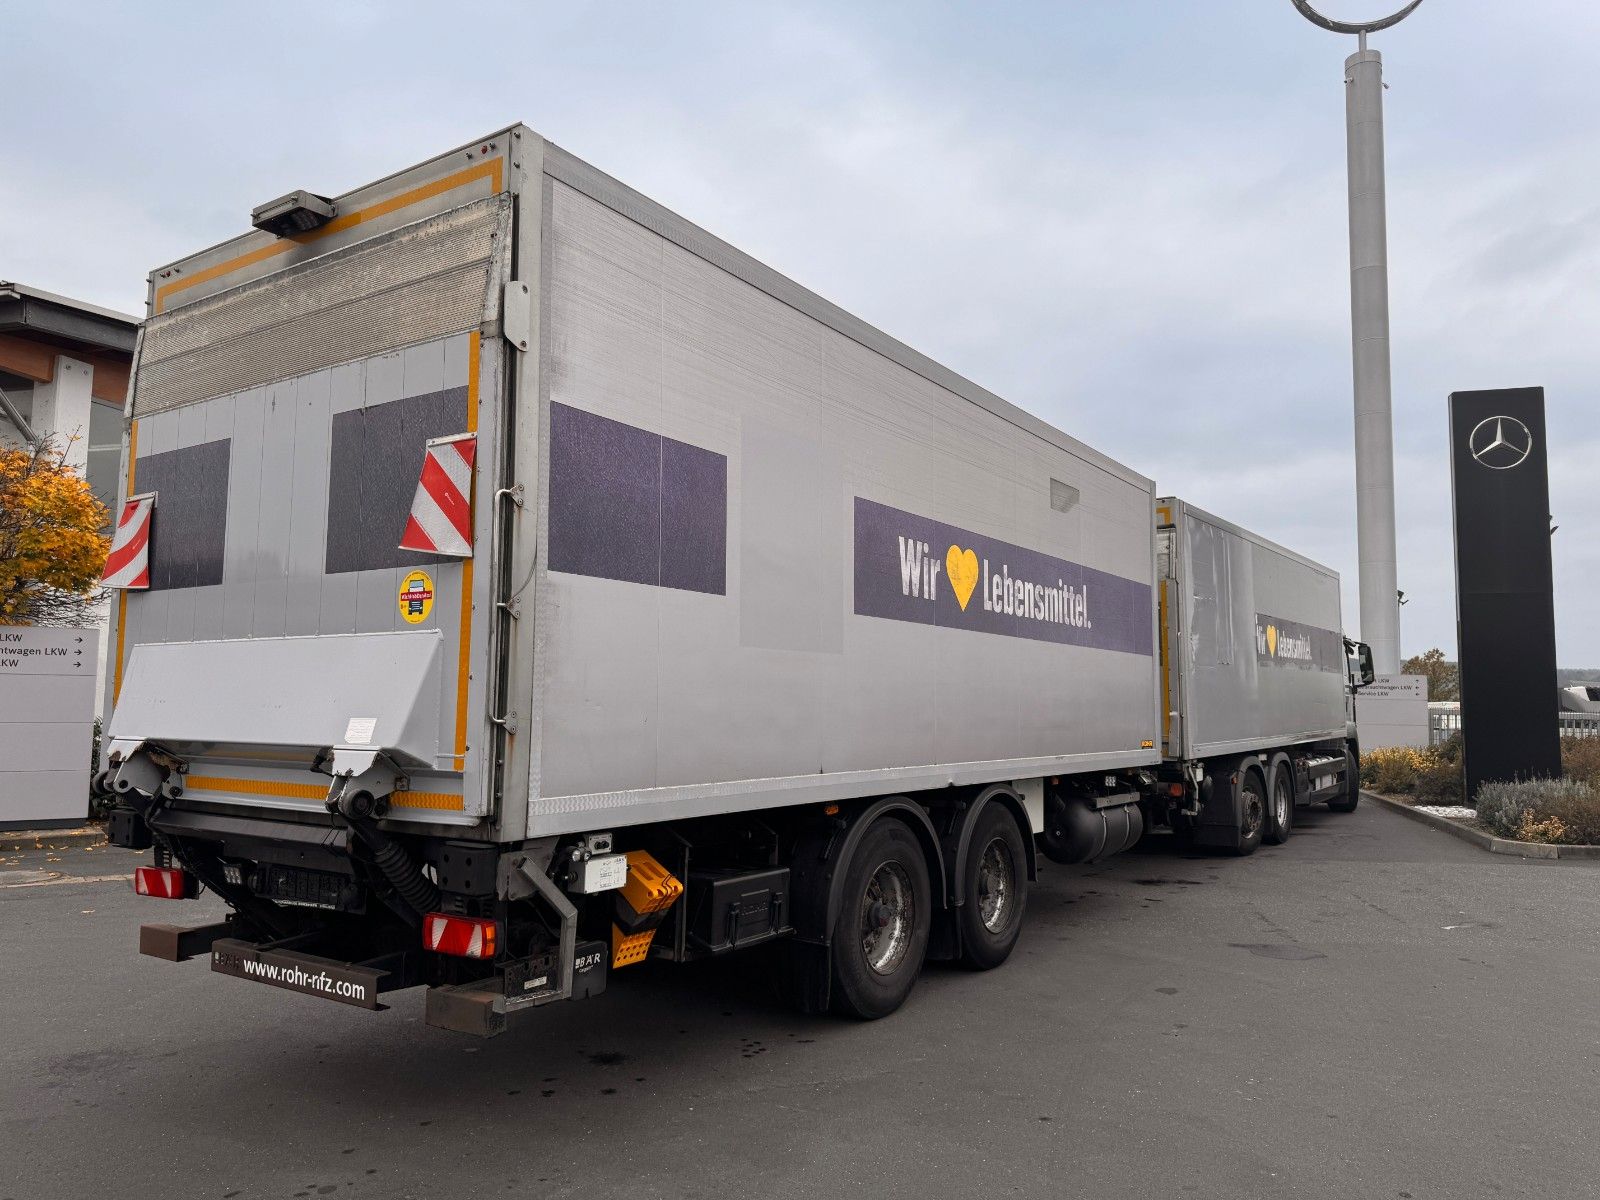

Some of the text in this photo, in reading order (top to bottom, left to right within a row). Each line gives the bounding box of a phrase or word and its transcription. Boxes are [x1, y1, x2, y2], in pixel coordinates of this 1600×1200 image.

[898, 536, 1092, 630] Wir Lebensmittel.
[44, 648, 68, 656] LKW
[580, 952, 601, 967] BÄR
